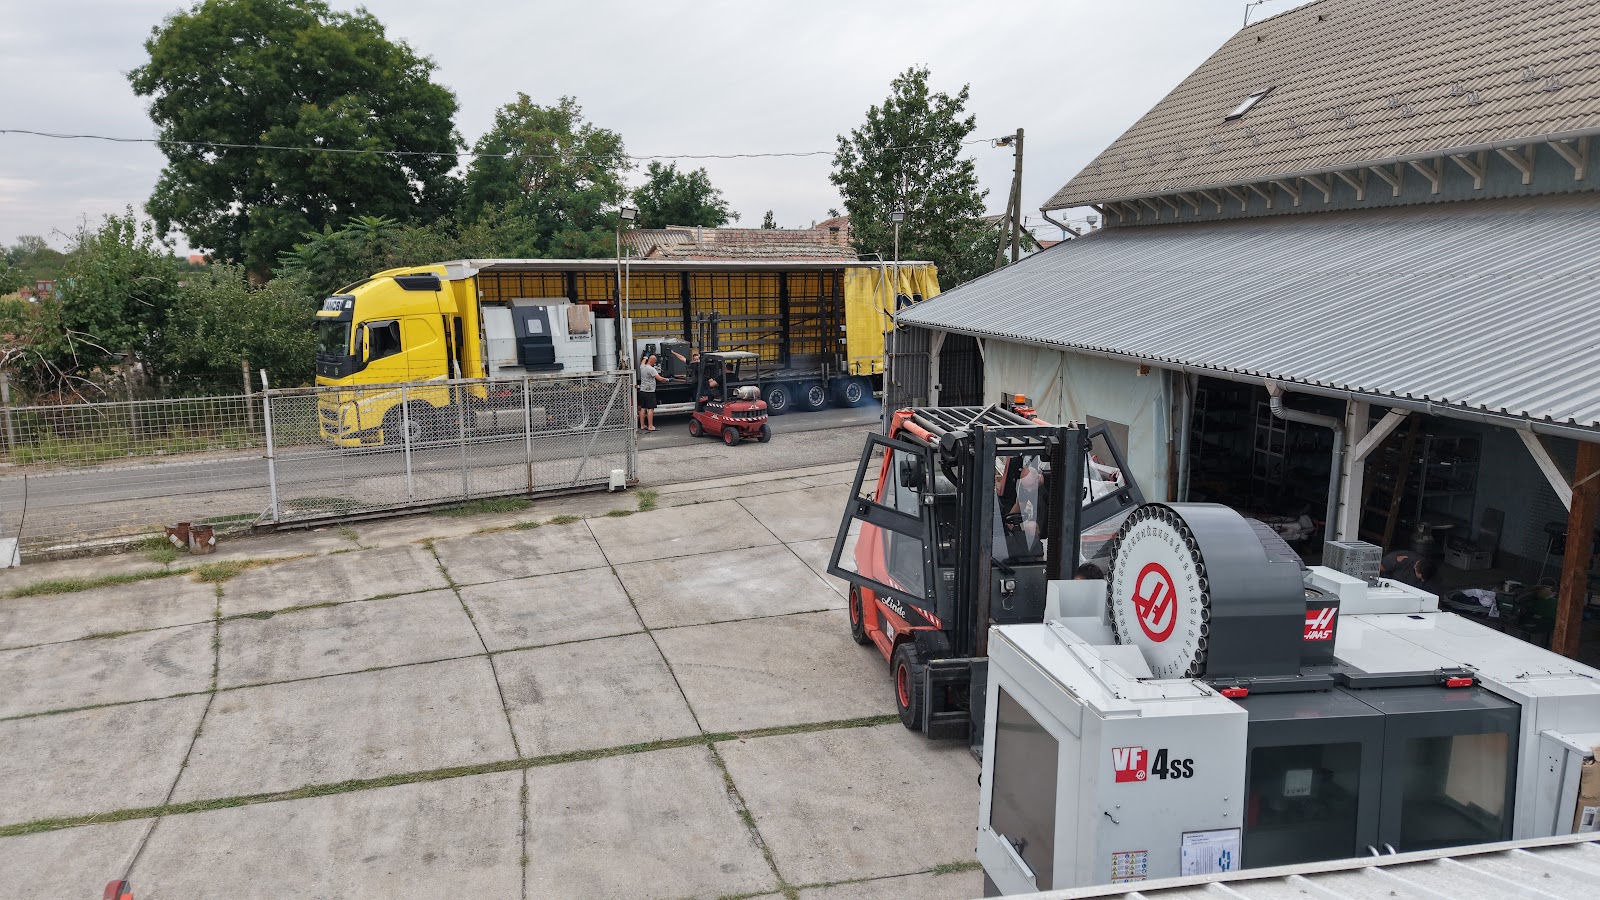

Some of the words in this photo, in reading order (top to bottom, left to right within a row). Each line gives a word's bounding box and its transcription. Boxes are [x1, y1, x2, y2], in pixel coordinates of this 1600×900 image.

[881, 597, 906, 618] Linde
[1304, 630, 1332, 640] HAAS
[1112, 746, 1143, 771] VF
